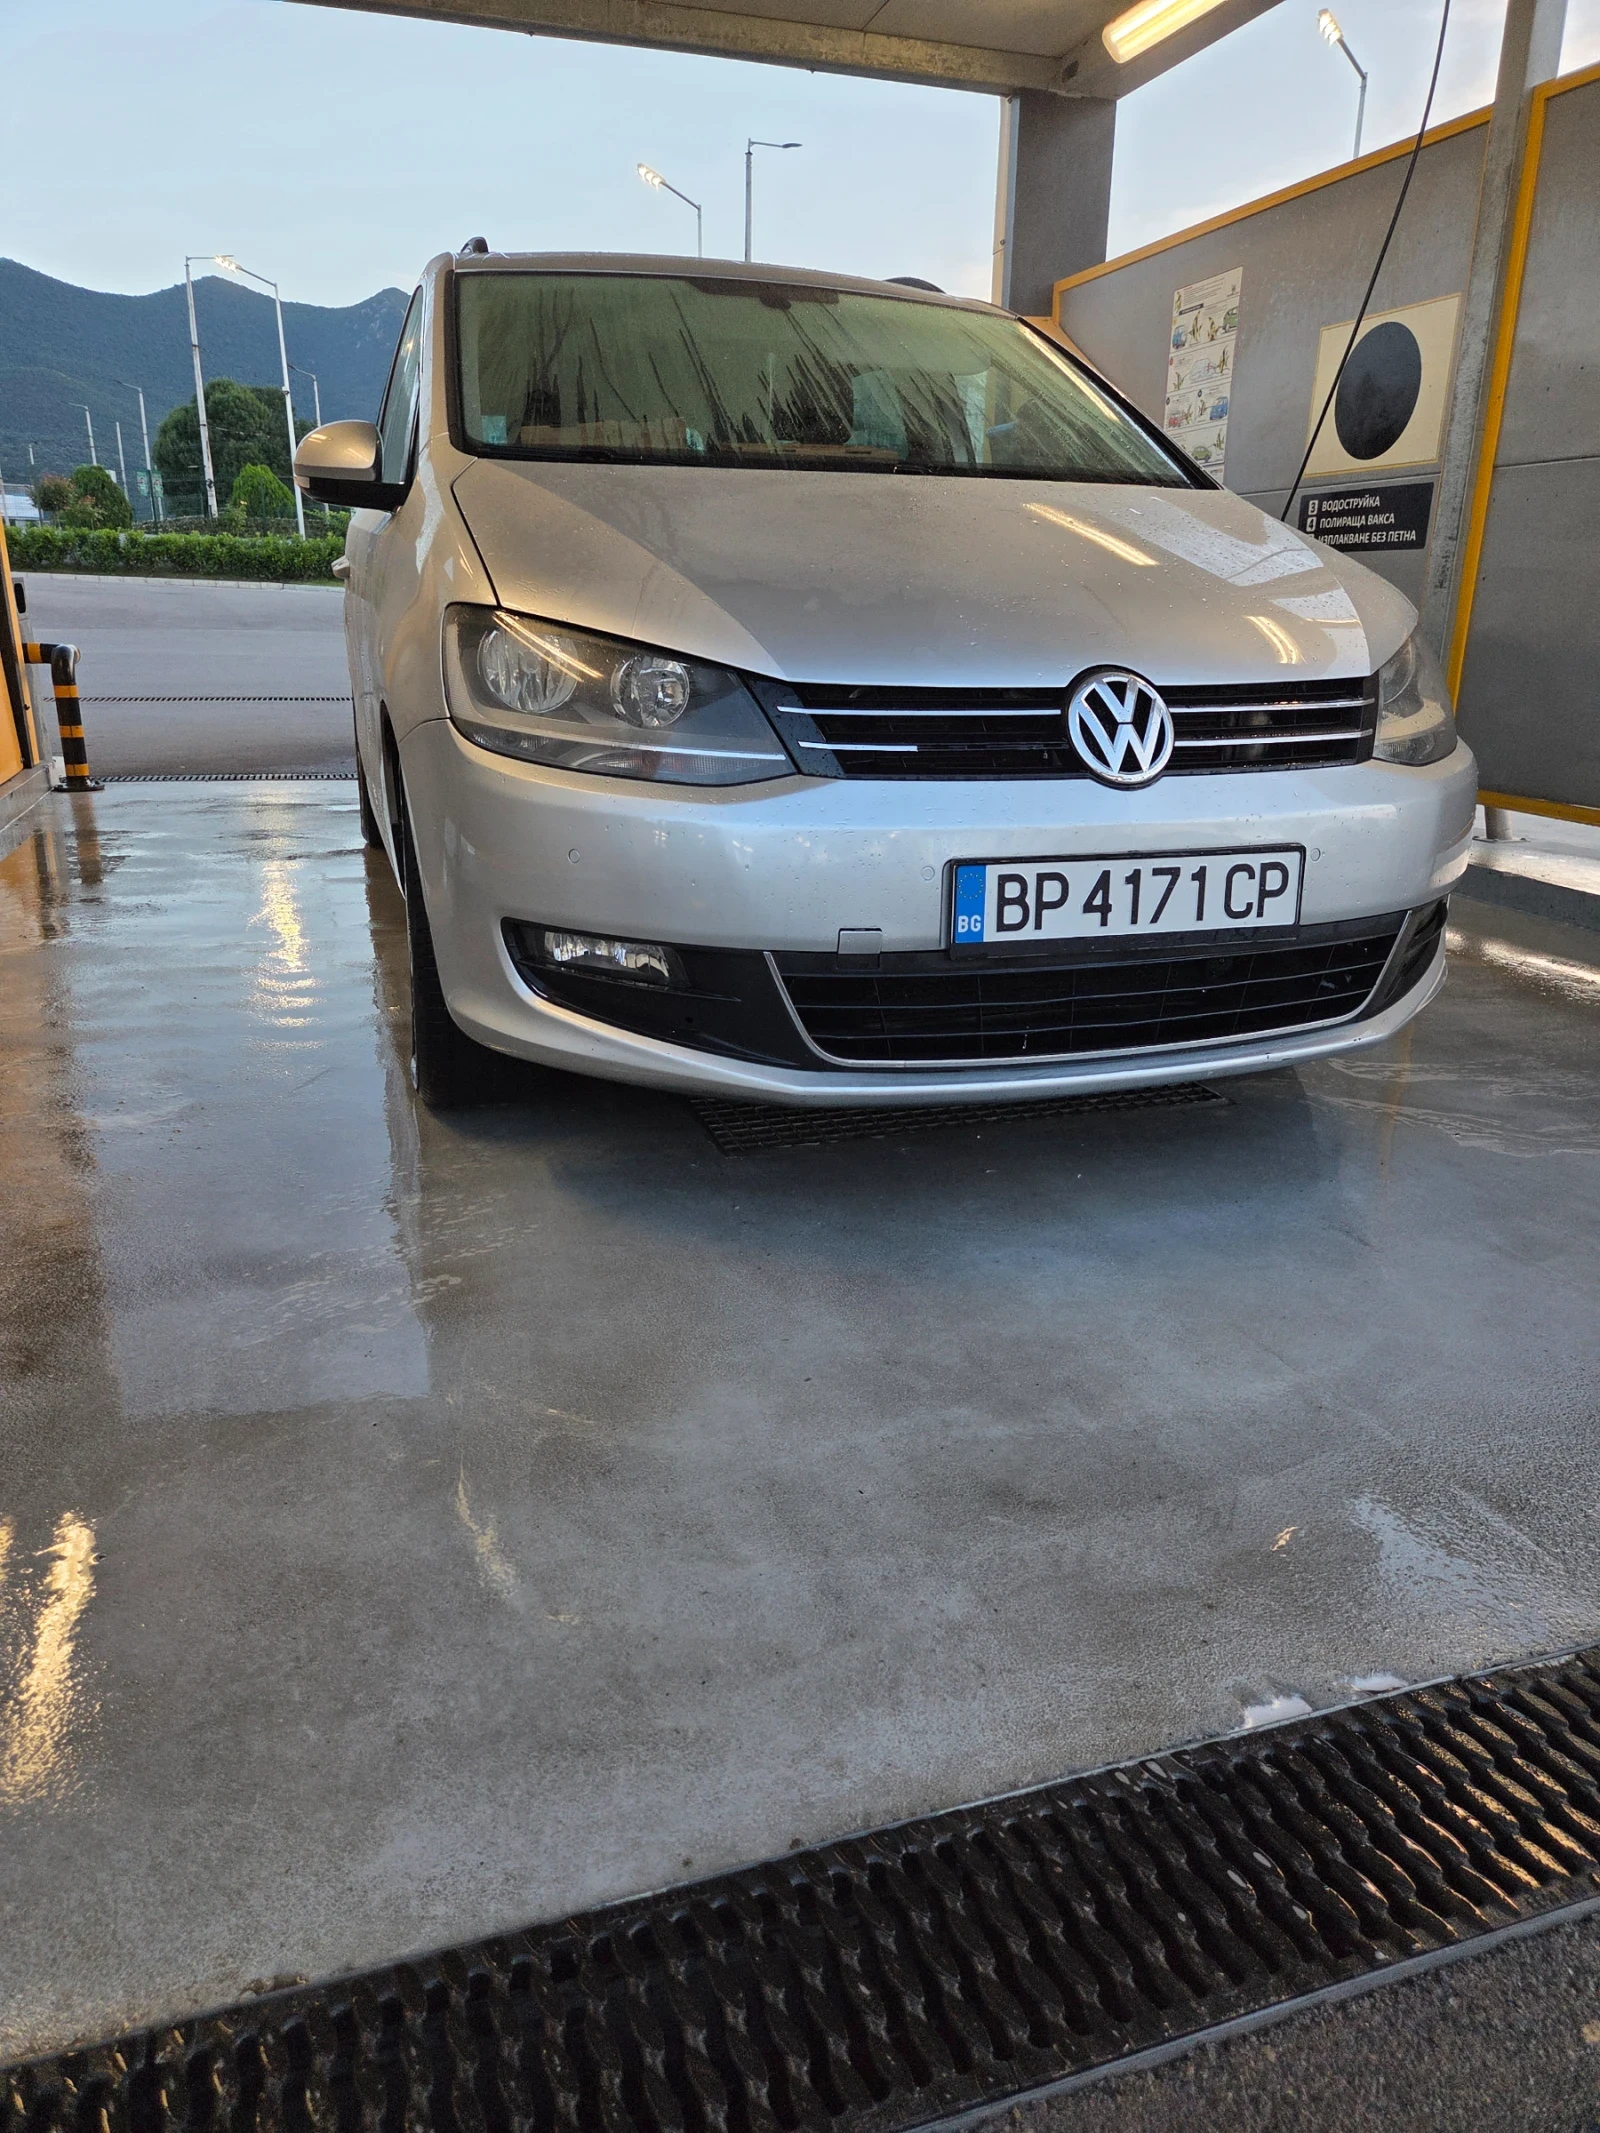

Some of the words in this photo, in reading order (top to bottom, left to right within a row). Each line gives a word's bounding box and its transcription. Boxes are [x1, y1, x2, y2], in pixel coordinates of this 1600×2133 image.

[1322, 495, 1380, 511] ВОДОСТРУЙКА
[1320, 515, 1366, 529] ПОЛИРАЩА
[1367, 513, 1395, 525] ВАКСА
[1371, 531, 1386, 543] БЕЗ
[1387, 530, 1416, 542] ПЕТНА
[996, 872, 1070, 933] BP
[1082, 865, 1208, 927] 4171
[1223, 861, 1290, 920] CP
[957, 915, 982, 934] BG
